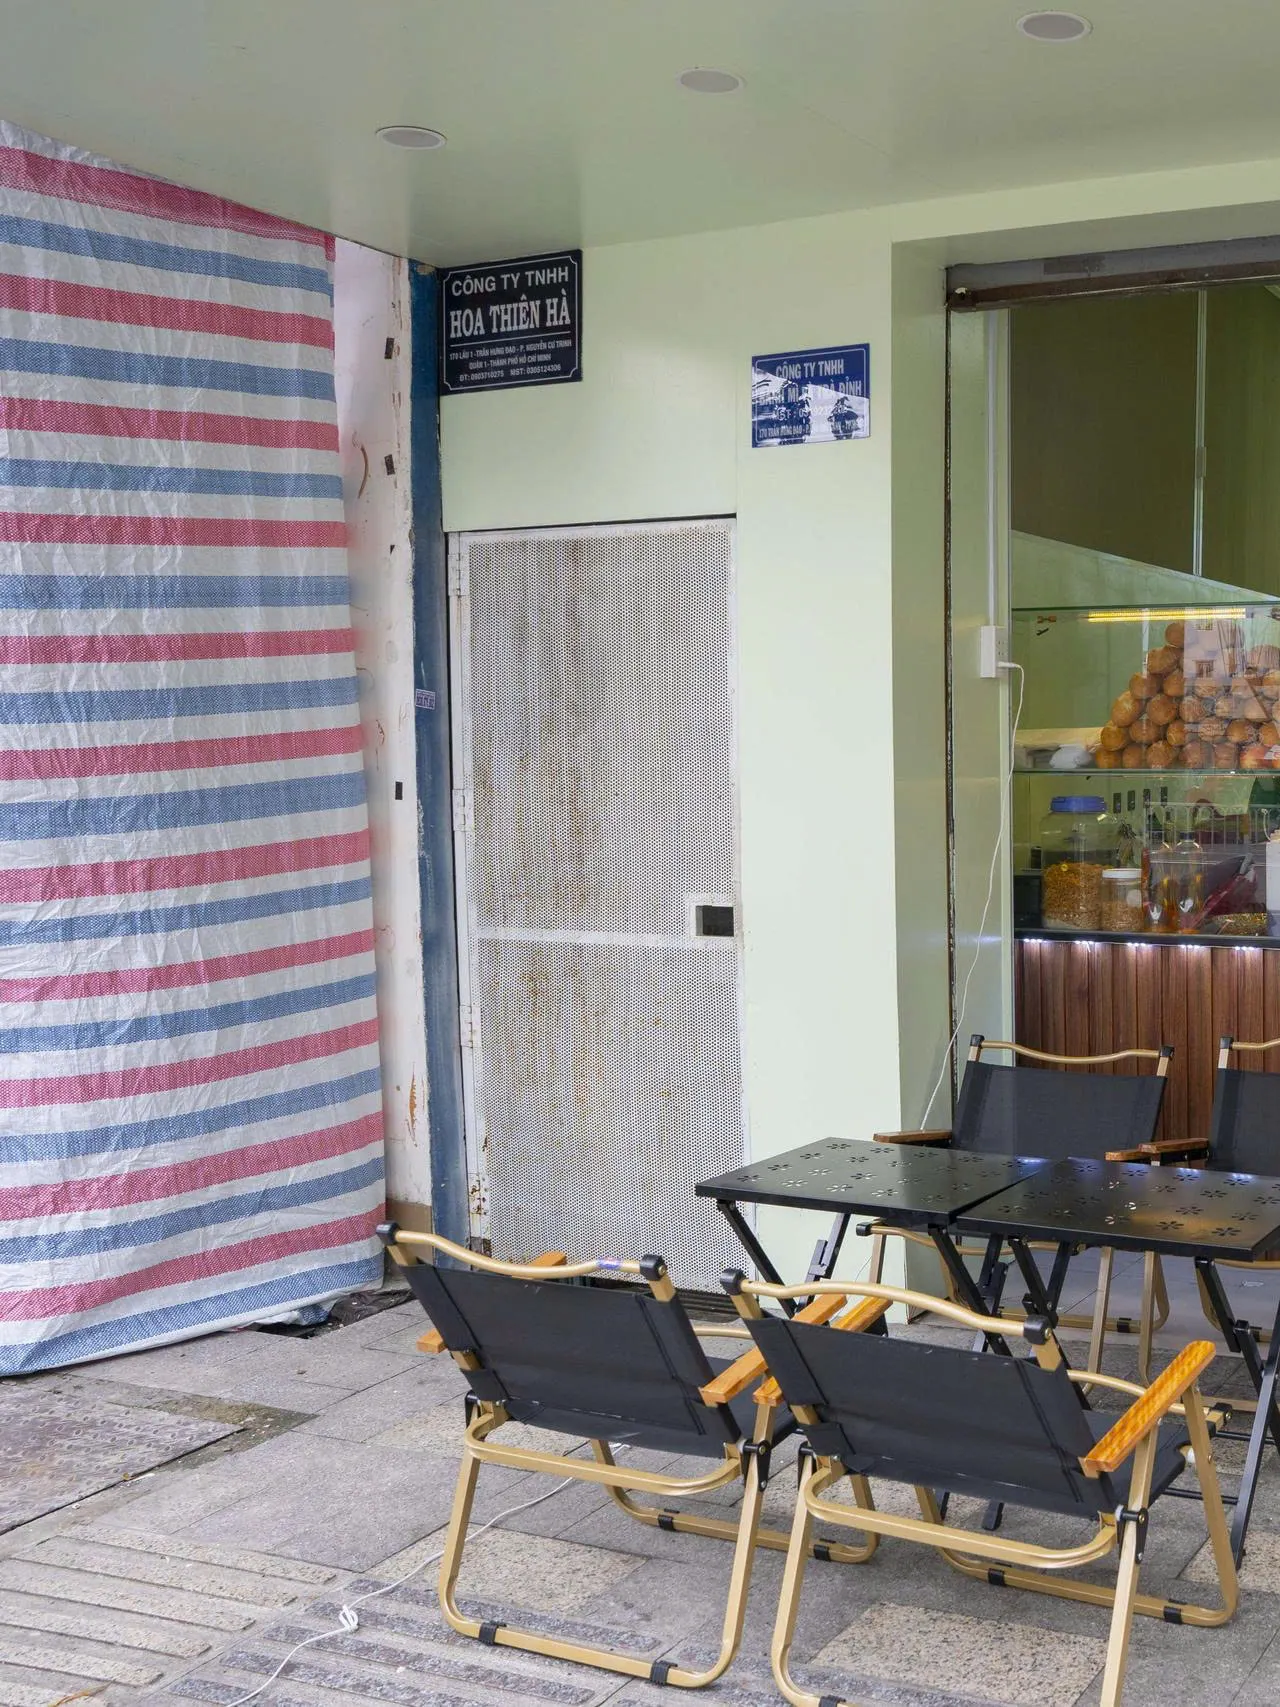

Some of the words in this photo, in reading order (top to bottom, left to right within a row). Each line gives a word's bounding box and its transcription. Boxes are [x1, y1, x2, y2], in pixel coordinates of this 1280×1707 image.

[452, 275, 496, 296] CÔNG
[501, 272, 521, 290] TY
[525, 266, 569, 286] TNHH
[450, 308, 485, 338] HOA
[489, 294, 540, 333] THIÊN
[546, 288, 571, 327] HÀ
[776, 361, 801, 380] CÔNG
[804, 362, 816, 378] TY
[818, 359, 844, 376] TNHH
